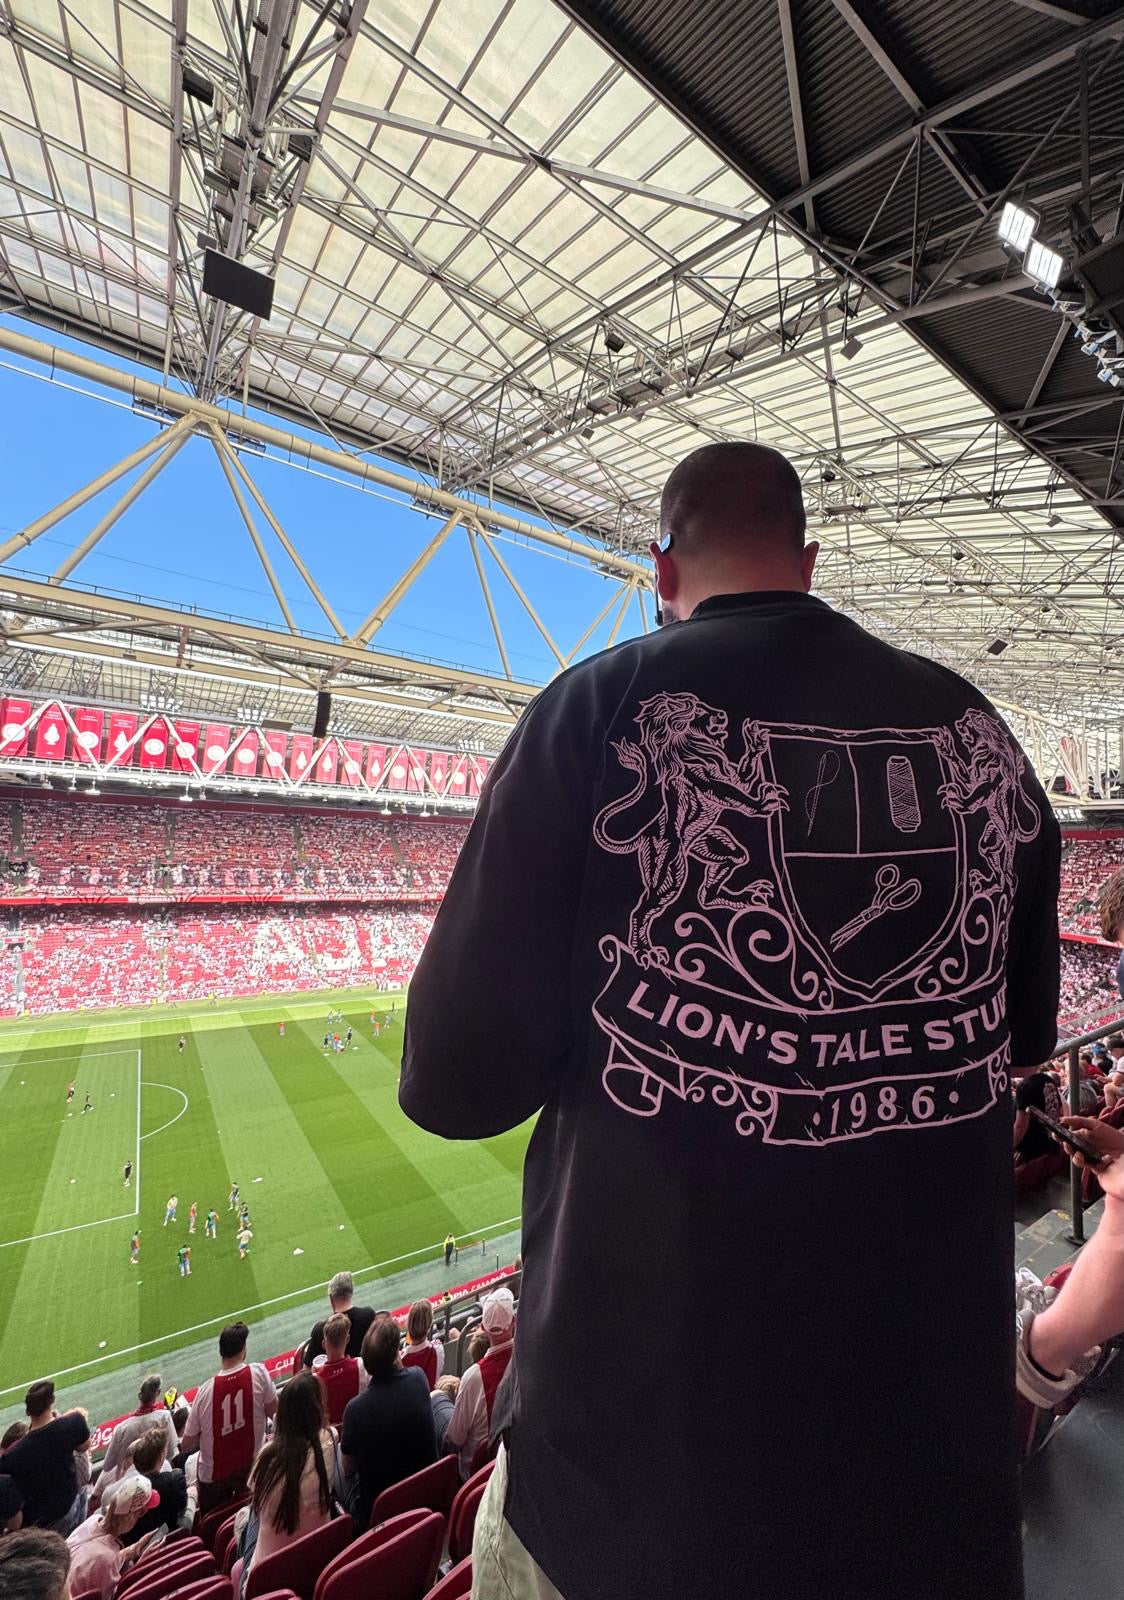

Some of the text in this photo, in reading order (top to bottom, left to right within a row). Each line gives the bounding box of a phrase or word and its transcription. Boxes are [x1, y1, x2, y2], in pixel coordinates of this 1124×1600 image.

[626, 981, 798, 1066] LION'S
[811, 1024, 912, 1068] TALE
[221, 1388, 246, 1437] 11
